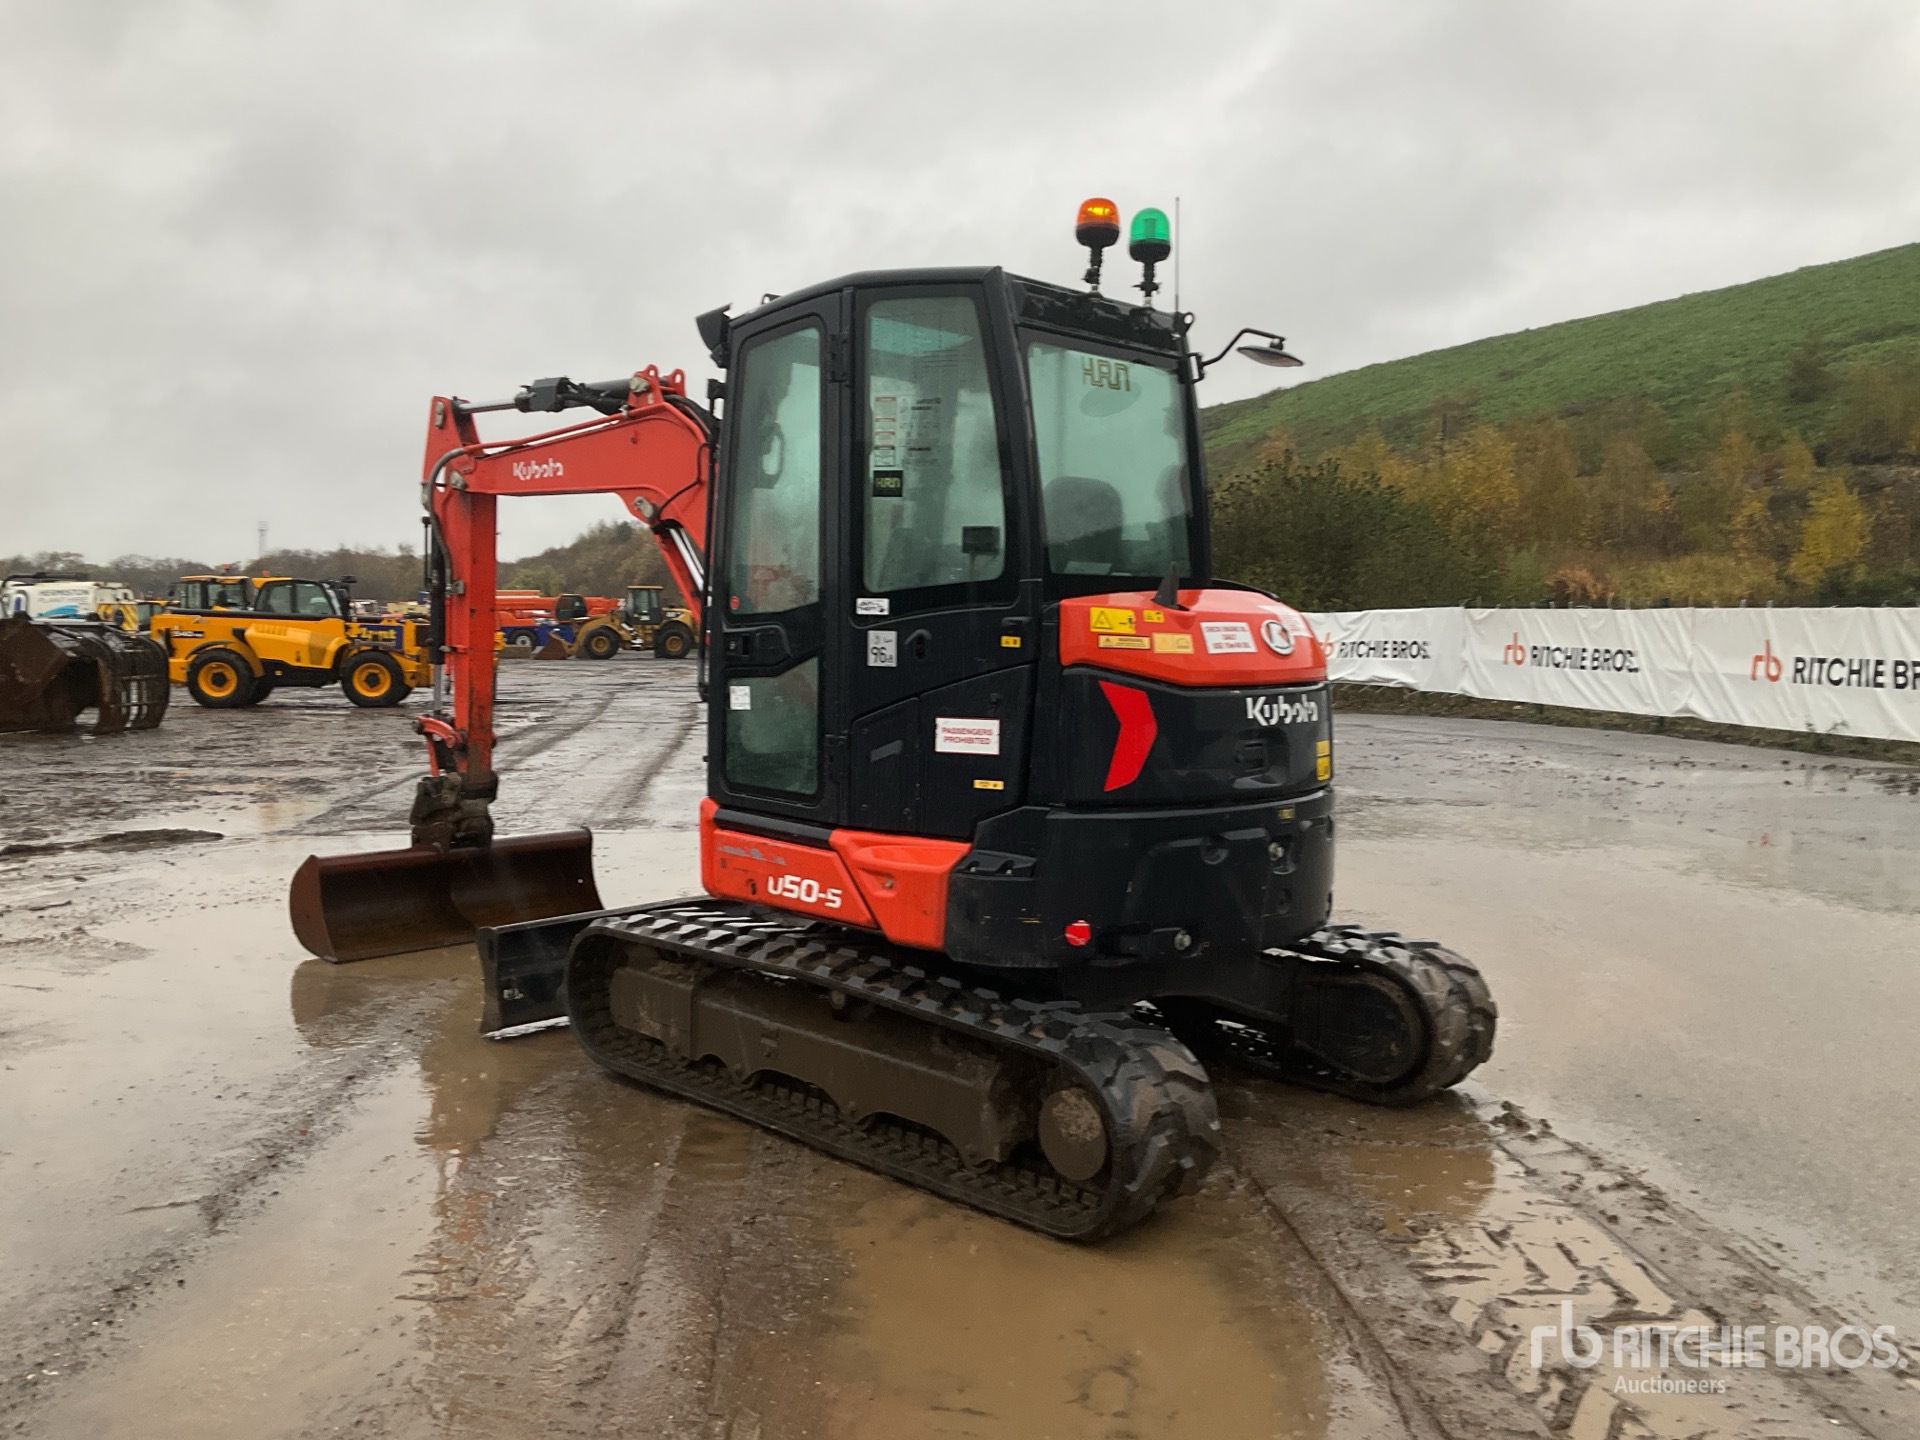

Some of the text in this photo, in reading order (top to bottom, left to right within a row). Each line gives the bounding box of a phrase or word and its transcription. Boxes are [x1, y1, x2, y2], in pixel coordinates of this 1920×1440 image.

[513, 457, 564, 480] Kubota
[1338, 640, 1388, 659] RITCHIE
[1530, 645, 1587, 671] RITCHIE
[1793, 656, 1886, 689] RITCHIE
[1245, 693, 1318, 726] Kubota
